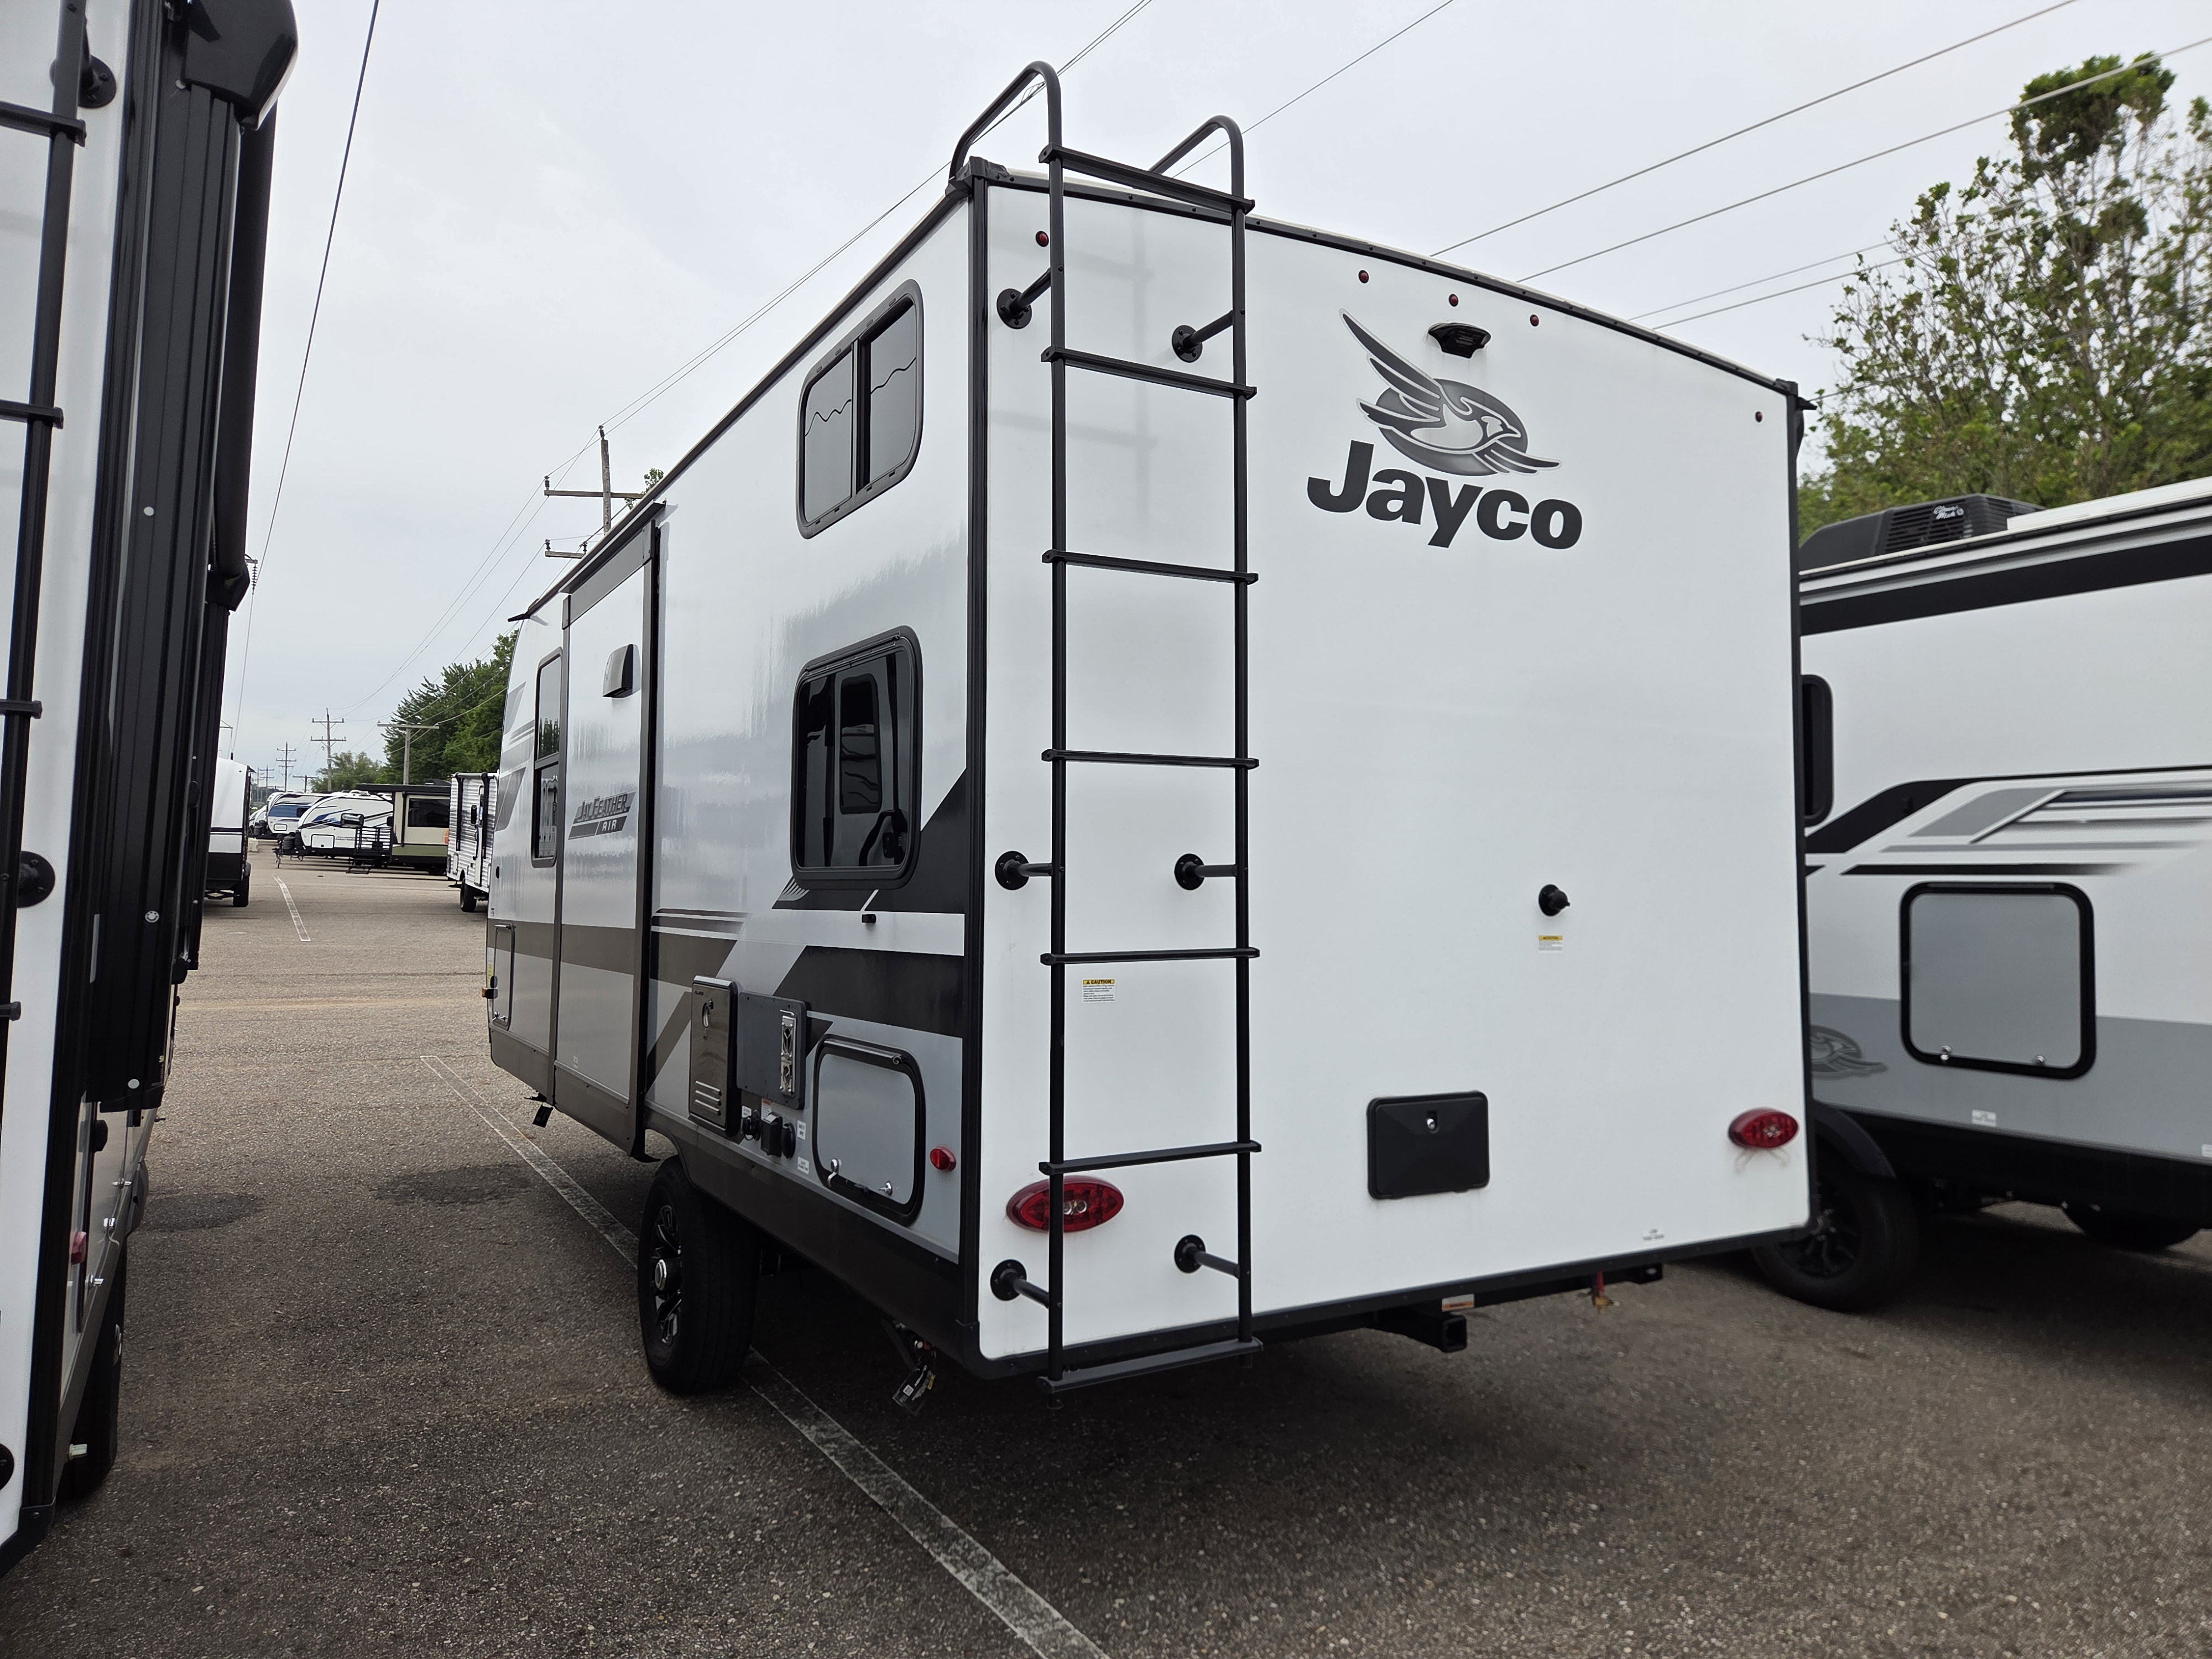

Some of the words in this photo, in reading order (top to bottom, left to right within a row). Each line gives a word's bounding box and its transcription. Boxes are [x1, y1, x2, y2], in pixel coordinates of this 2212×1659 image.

[1307, 440, 1583, 550] Jayco
[577, 800, 592, 822] JAY
[591, 791, 628, 819] FEATHER
[602, 820, 617, 831] AIR
